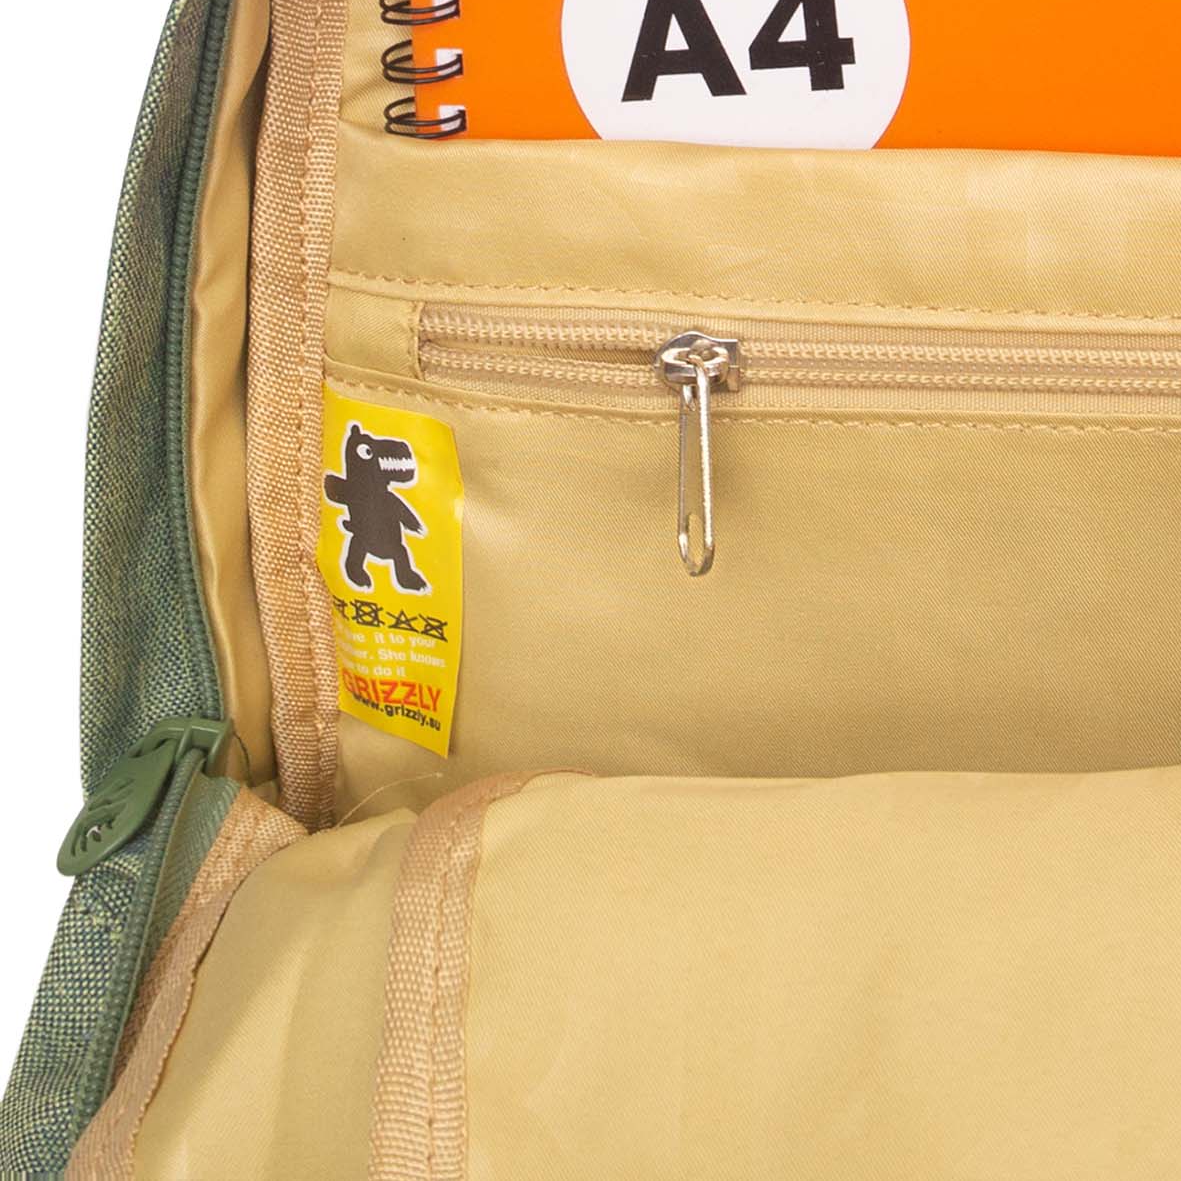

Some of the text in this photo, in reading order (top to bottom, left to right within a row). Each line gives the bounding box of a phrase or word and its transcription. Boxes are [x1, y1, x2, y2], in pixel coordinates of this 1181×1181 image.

[389, 632, 405, 644] to
[409, 635, 436, 648] your
[378, 649, 406, 661] She
[374, 665, 391, 676] do
[342, 668, 441, 712] GRIZZLY
[352, 693, 441, 731] www.grizzly.su
